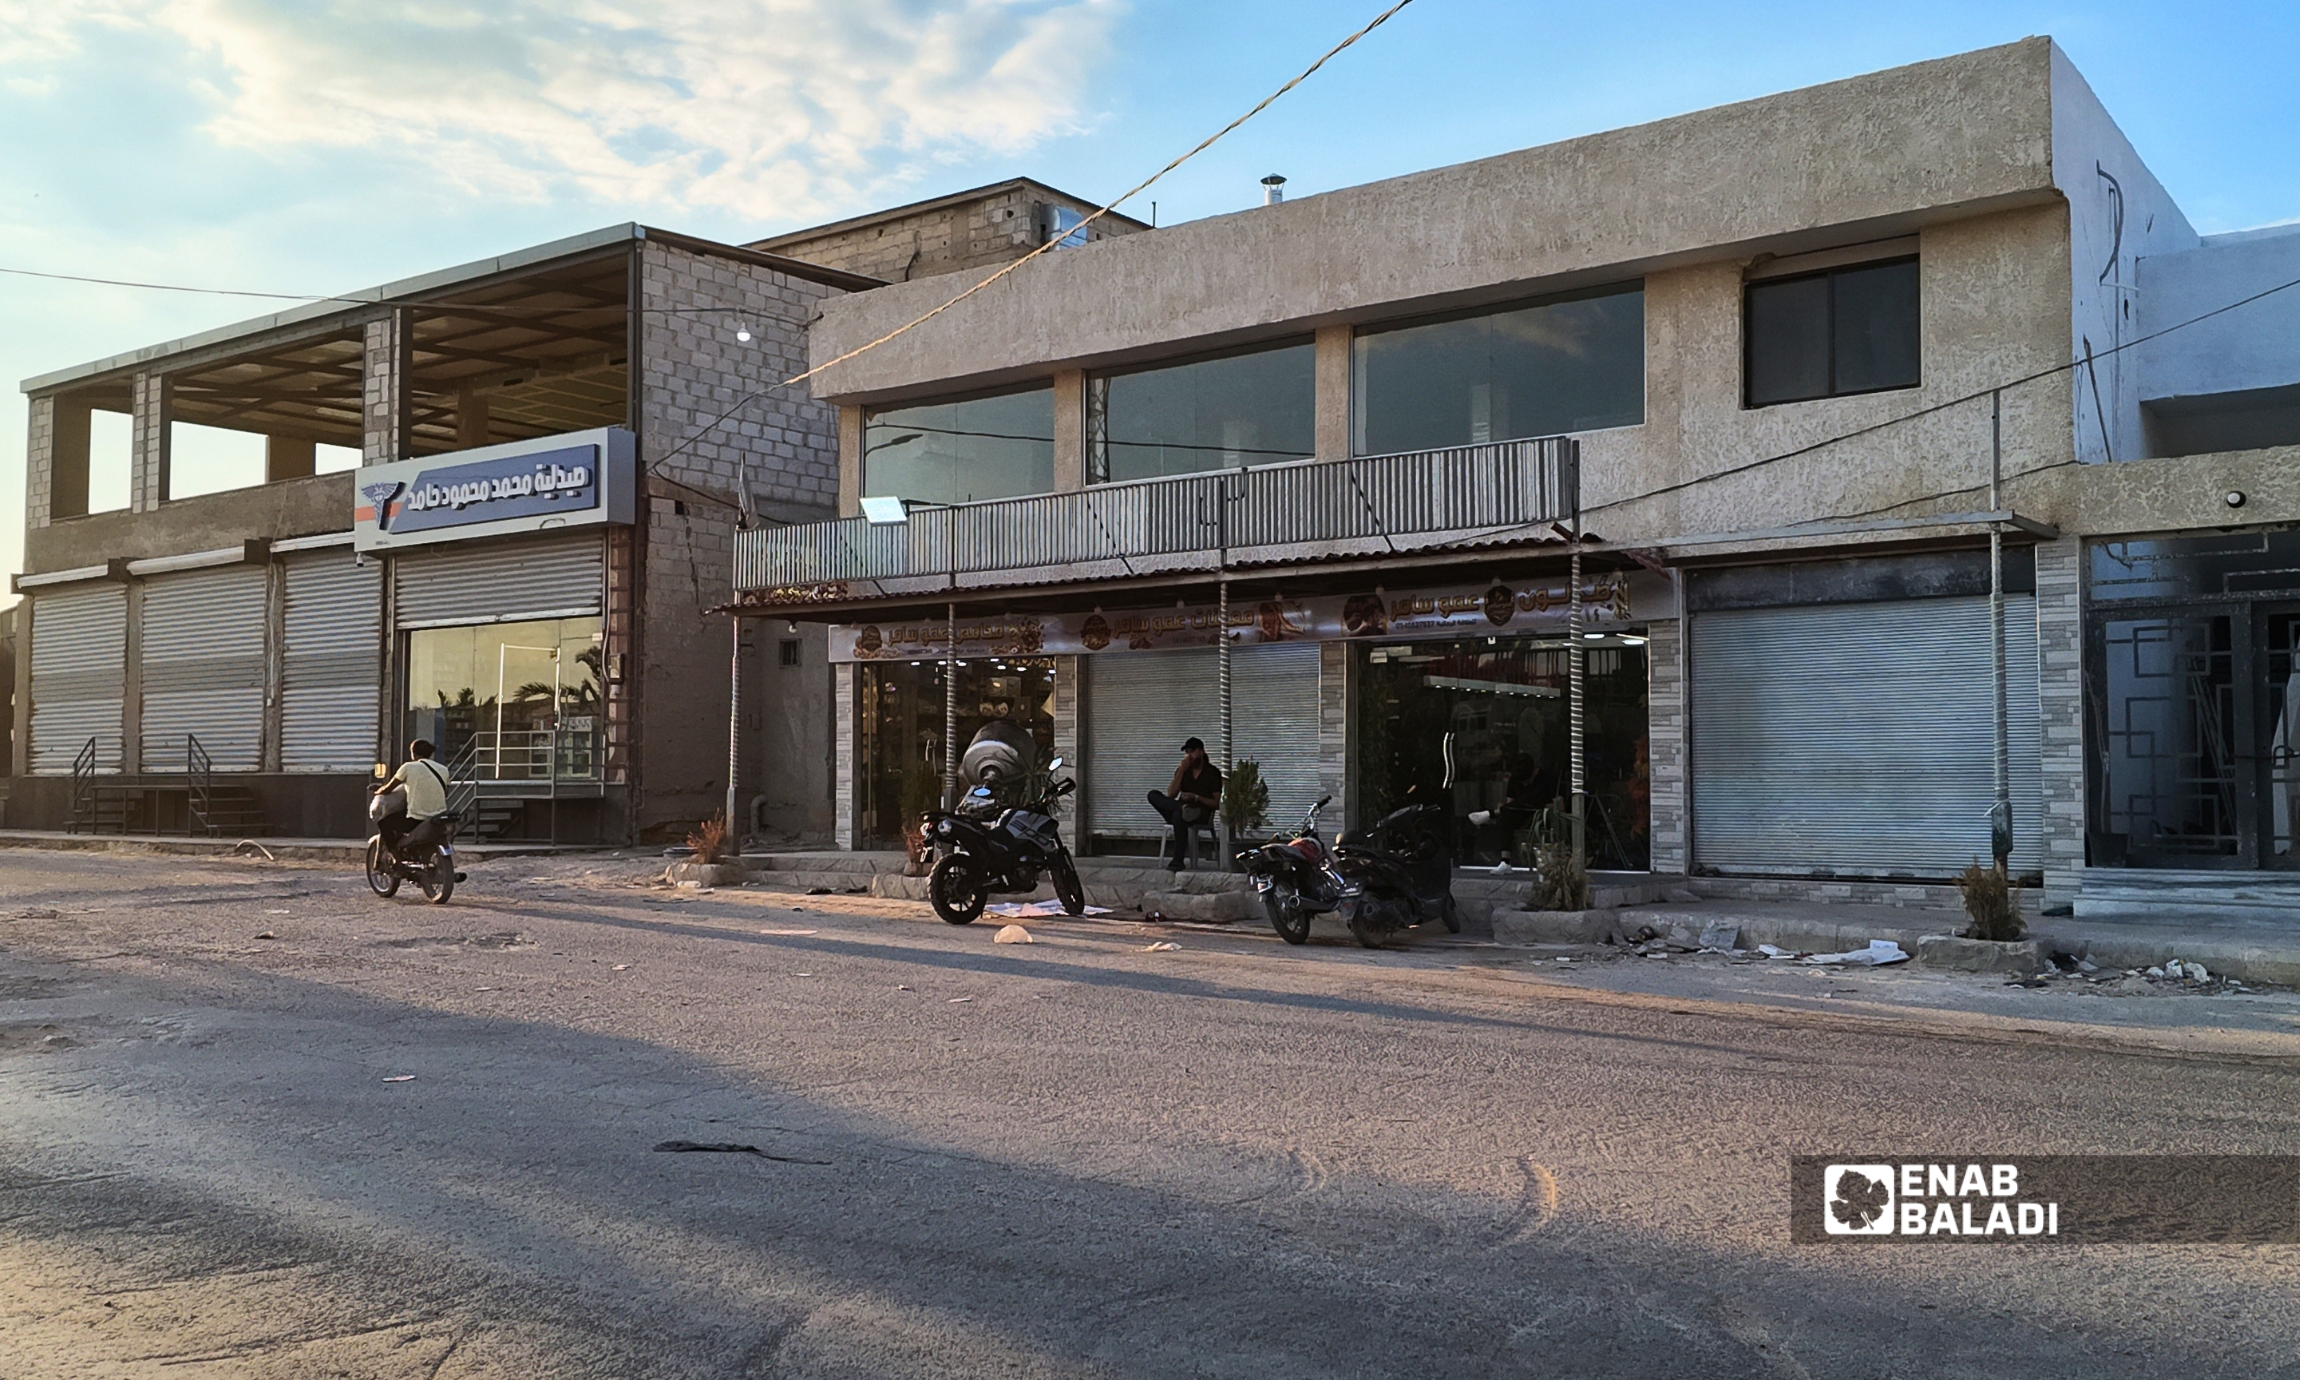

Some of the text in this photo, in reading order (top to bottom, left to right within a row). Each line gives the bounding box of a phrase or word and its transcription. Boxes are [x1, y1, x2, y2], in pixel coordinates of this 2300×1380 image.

[492, 474, 532, 498] محمد
[535, 464, 588, 498] صيدلية
[442, 480, 489, 509] محمود
[1390, 594, 1435, 622] سامر
[1438, 594, 1480, 619] عمو
[1114, 615, 1150, 639] سامر
[1153, 614, 1187, 636] عمو
